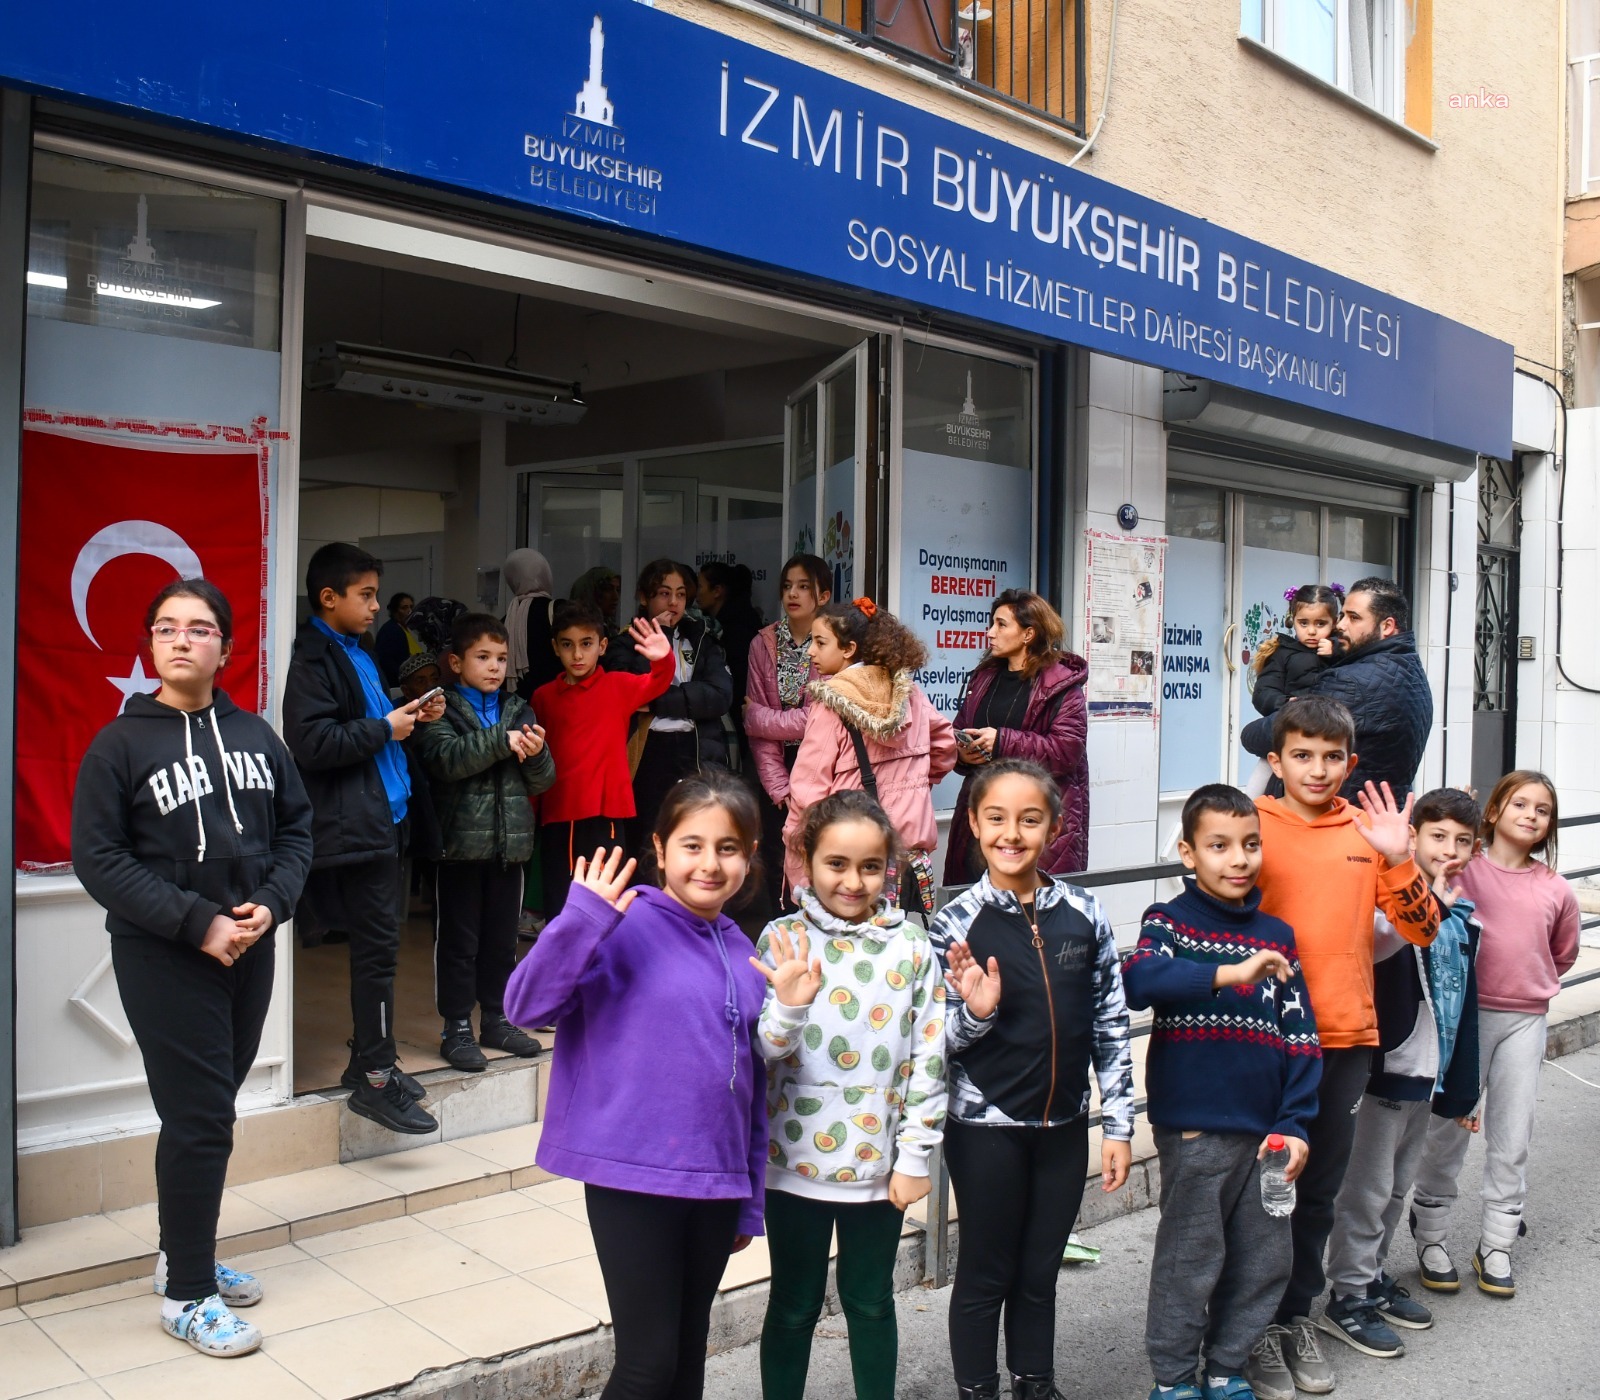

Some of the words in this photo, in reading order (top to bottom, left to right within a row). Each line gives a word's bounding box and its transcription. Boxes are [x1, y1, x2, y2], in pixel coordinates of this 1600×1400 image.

[719, 60, 910, 196] İZMİR
[932, 146, 1201, 292] BÜYÜKŞEHİR
[1217, 251, 1401, 361] BELEDİYESİ
[847, 218, 977, 293] SOSYAL
[985, 258, 1137, 338] HİZMETLER
[1144, 307, 1232, 364] DAİRESİ
[1238, 337, 1347, 398] BAŞKANLIĞI
[919, 548, 1007, 573] Dayanışmanın
[931, 574, 996, 598] BEREKETİ
[922, 603, 991, 625] Paylaşman
[936, 626, 989, 649] LEZZETİ
[1163, 622, 1203, 646] İZİZMİR
[1162, 655, 1211, 677] YANIŞMA
[1162, 682, 1202, 700] OKTASI
